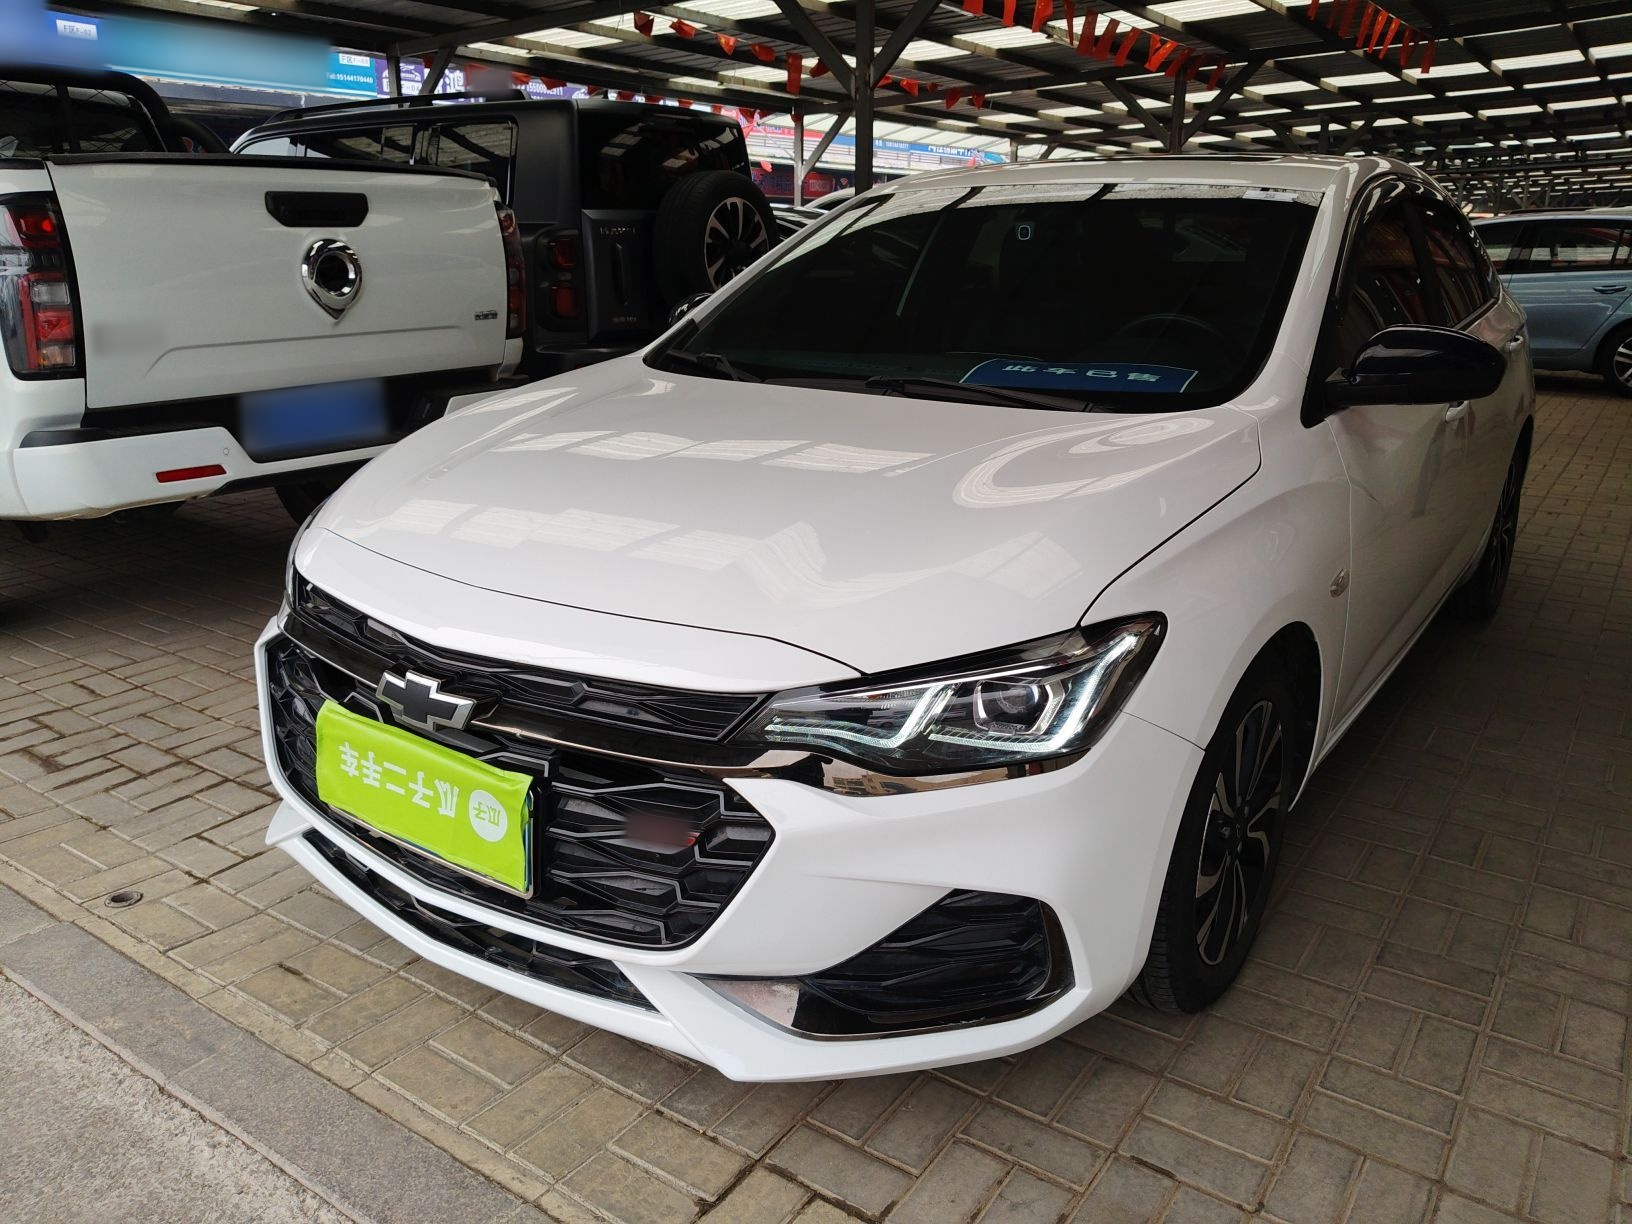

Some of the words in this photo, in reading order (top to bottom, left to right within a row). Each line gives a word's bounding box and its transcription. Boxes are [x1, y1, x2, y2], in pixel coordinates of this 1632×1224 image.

[1001, 364, 1162, 382] 此车已售
[338, 741, 460, 818] 瓜子二手车
[472, 801, 501, 827] 瓜子
